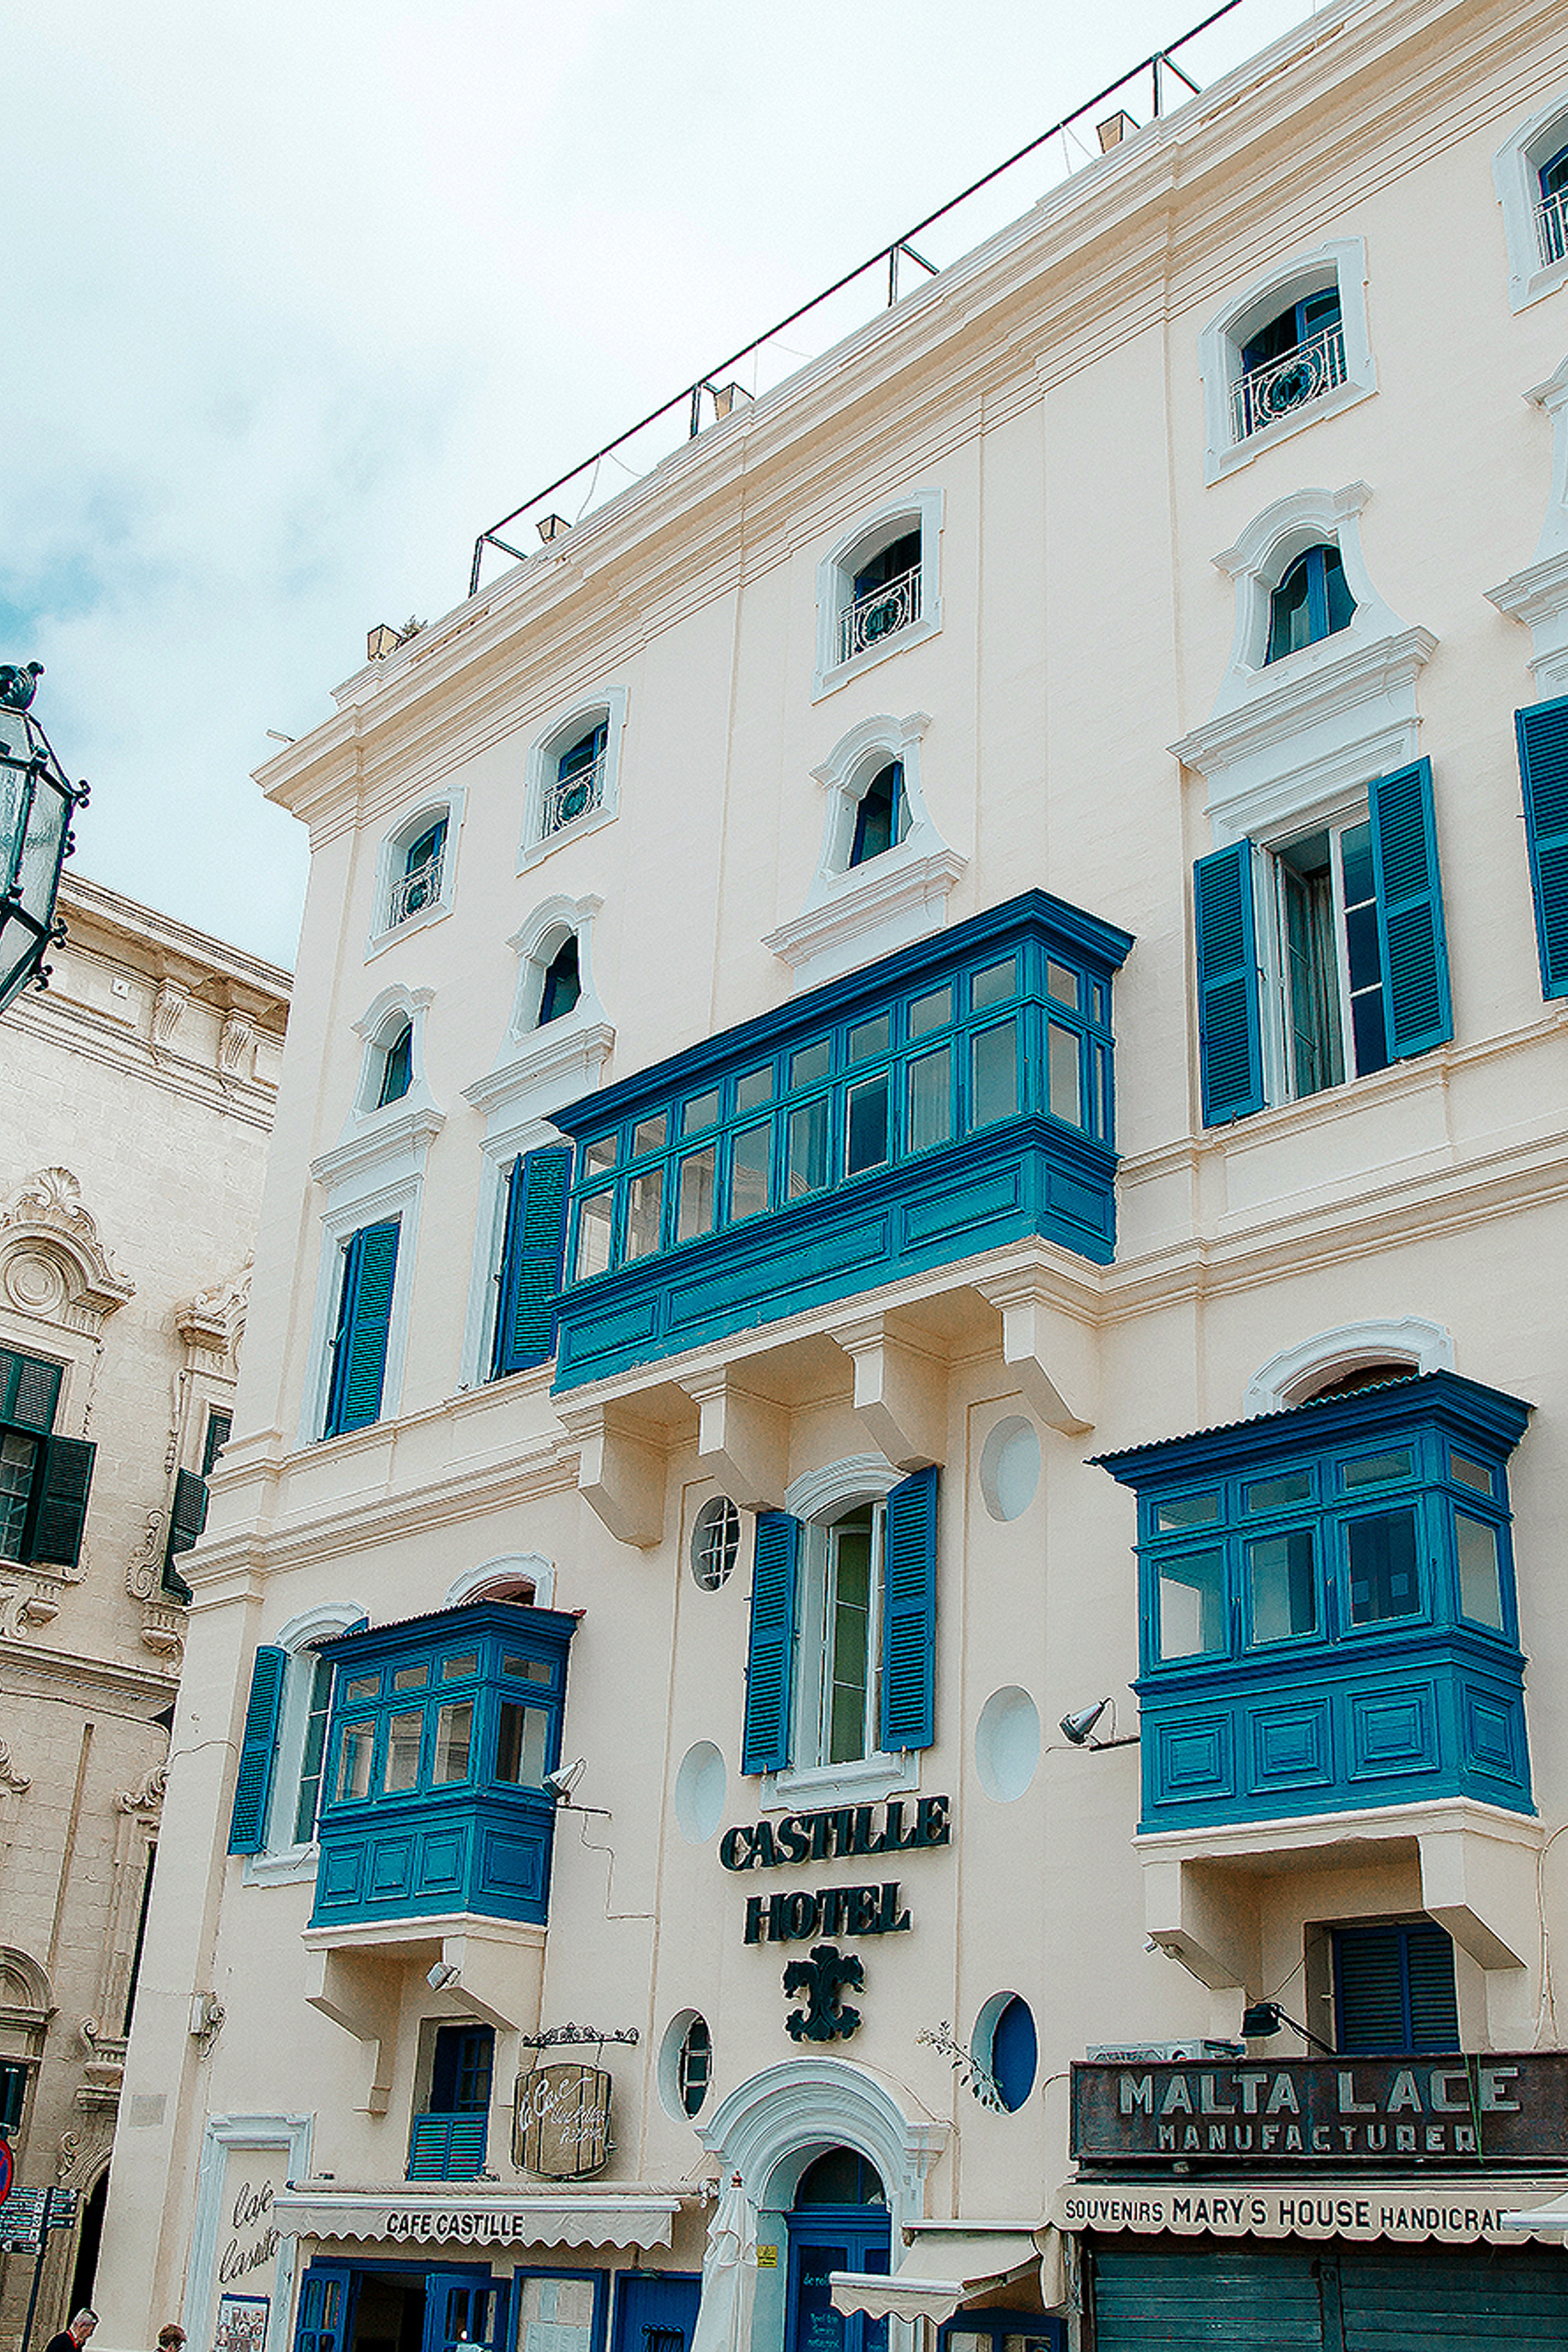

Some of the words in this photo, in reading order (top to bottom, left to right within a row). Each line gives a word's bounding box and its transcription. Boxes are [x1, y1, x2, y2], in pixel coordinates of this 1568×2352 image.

[720, 1795, 952, 1871] CASTILLE
[744, 1880, 912, 1944] HOTEL
[1120, 2071, 1300, 2114] MALTA
[1338, 2067, 1522, 2113] LACE
[1158, 2124, 1478, 2152] MANUFACTURER
[387, 2212, 431, 2234] CAFE
[436, 2214, 524, 2236] CASTILLE
[1065, 2199, 1164, 2222] SOUVENIRS
[1173, 2195, 1267, 2226] MARY'S
[1280, 2199, 1371, 2229] HOUSE
